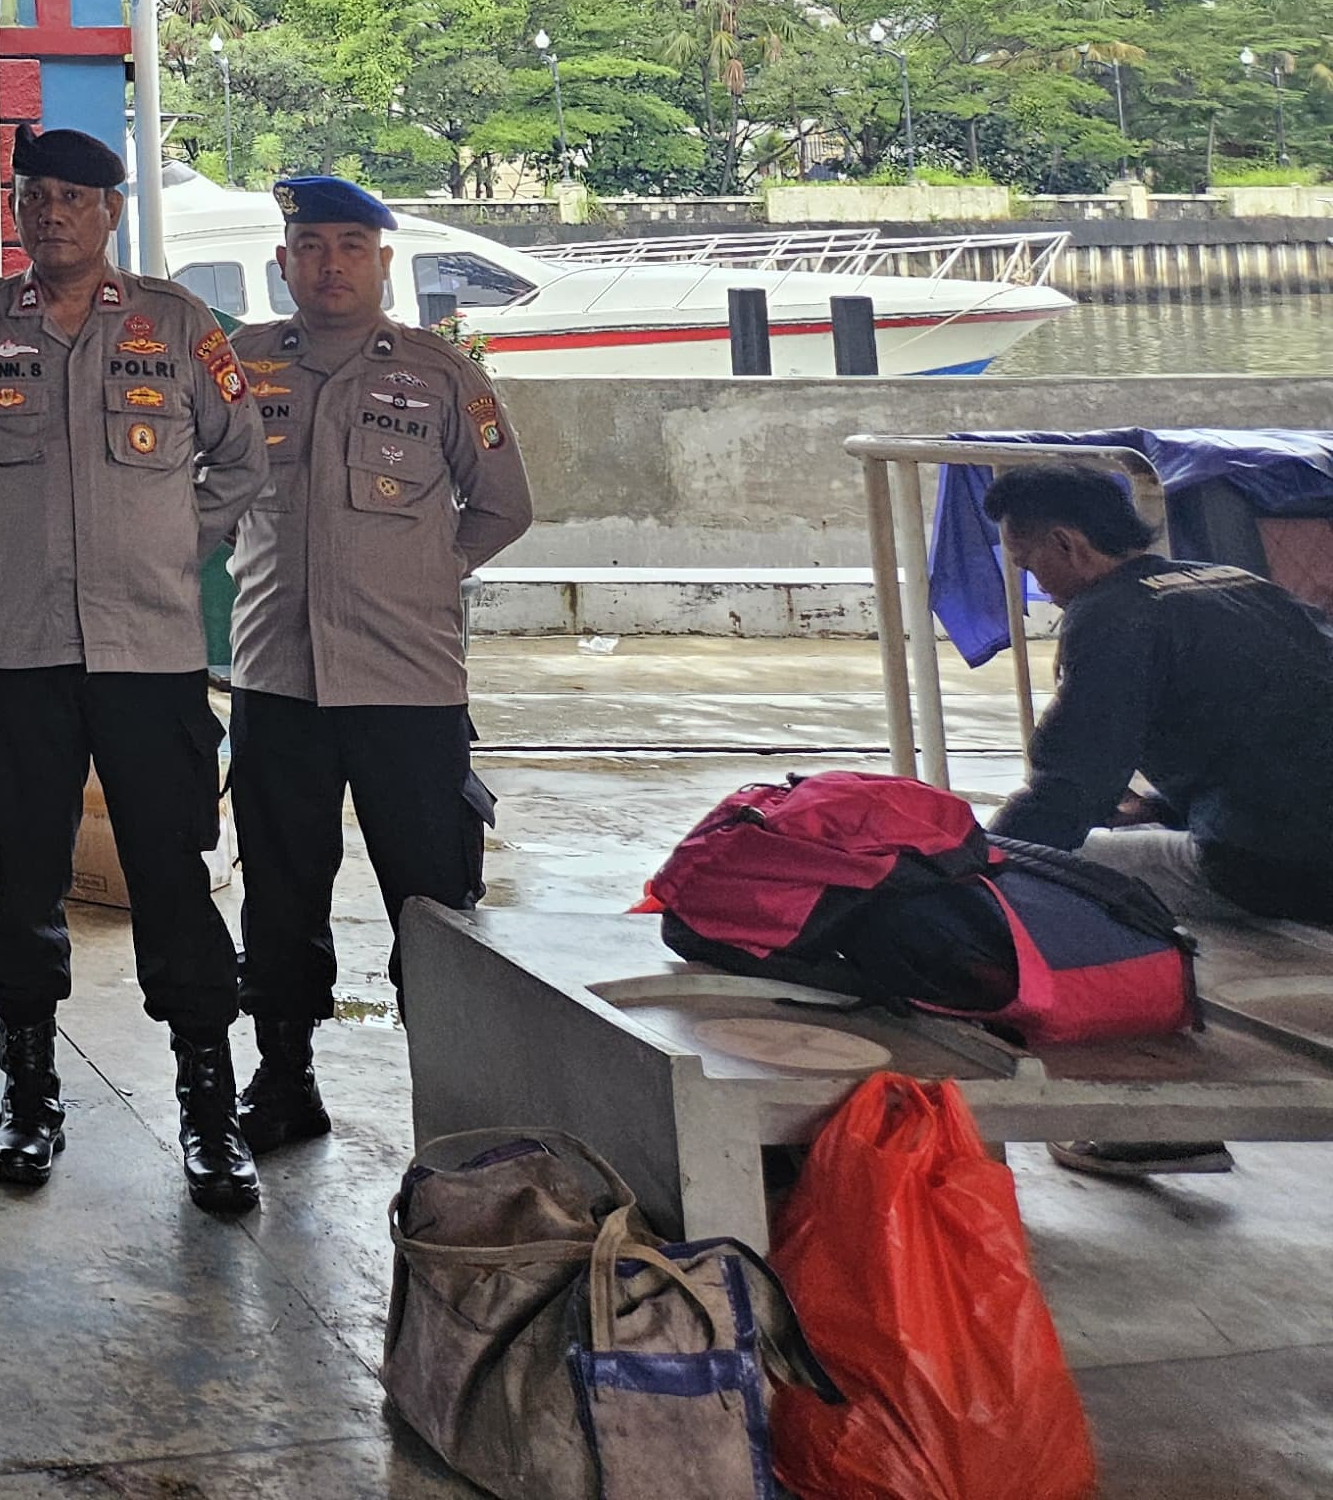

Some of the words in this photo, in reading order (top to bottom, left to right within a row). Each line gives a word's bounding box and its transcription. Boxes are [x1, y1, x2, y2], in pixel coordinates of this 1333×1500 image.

[109, 359, 176, 379] POLRI
[261, 404, 290, 418] ON
[362, 411, 428, 440] POLRI
